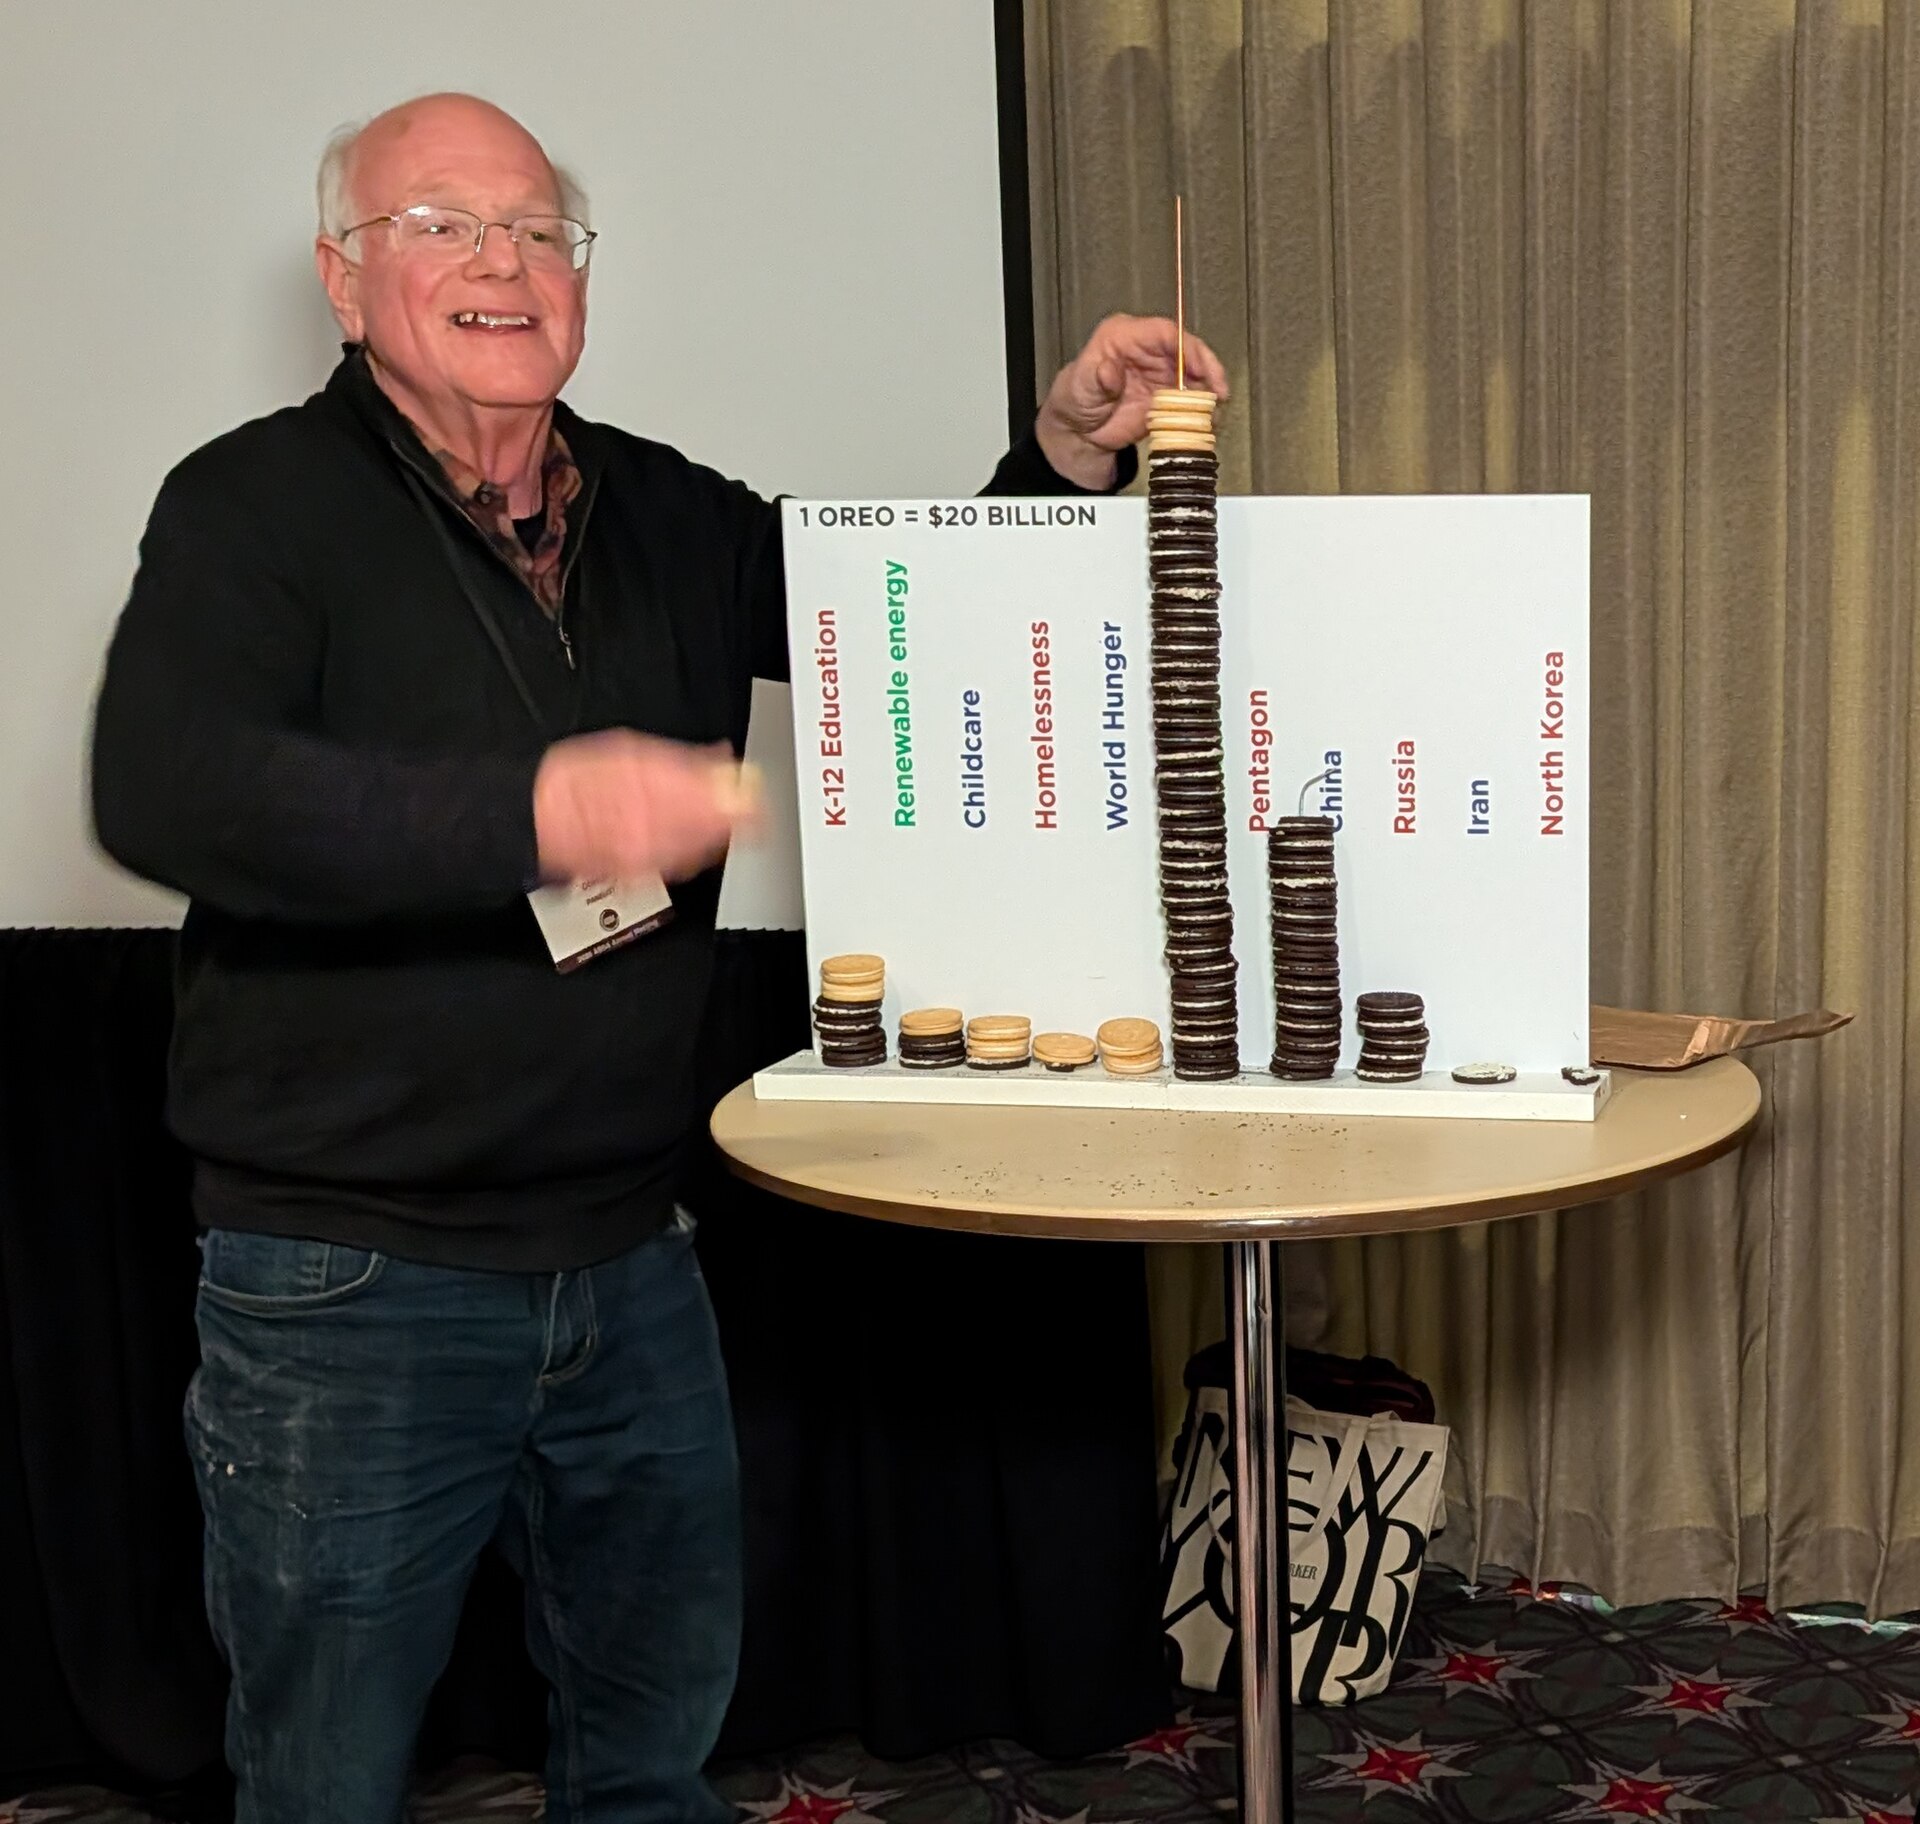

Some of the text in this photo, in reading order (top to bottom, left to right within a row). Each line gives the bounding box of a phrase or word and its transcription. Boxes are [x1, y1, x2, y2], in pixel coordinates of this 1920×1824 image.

[799, 504, 1096, 529] 1 OREO = $20 BILLION
[814, 610, 847, 826] K-12 Education
[885, 559, 916, 827] Renewable energy
[960, 689, 986, 829] Childcare
[1030, 621, 1057, 829] Homelessness
[1101, 621, 1129, 831] World Hunger
[1248, 690, 1273, 832] Pentagon
[1539, 651, 1564, 835] North Korea
[1391, 740, 1416, 834] Russia
[1466, 779, 1489, 835] Iran
